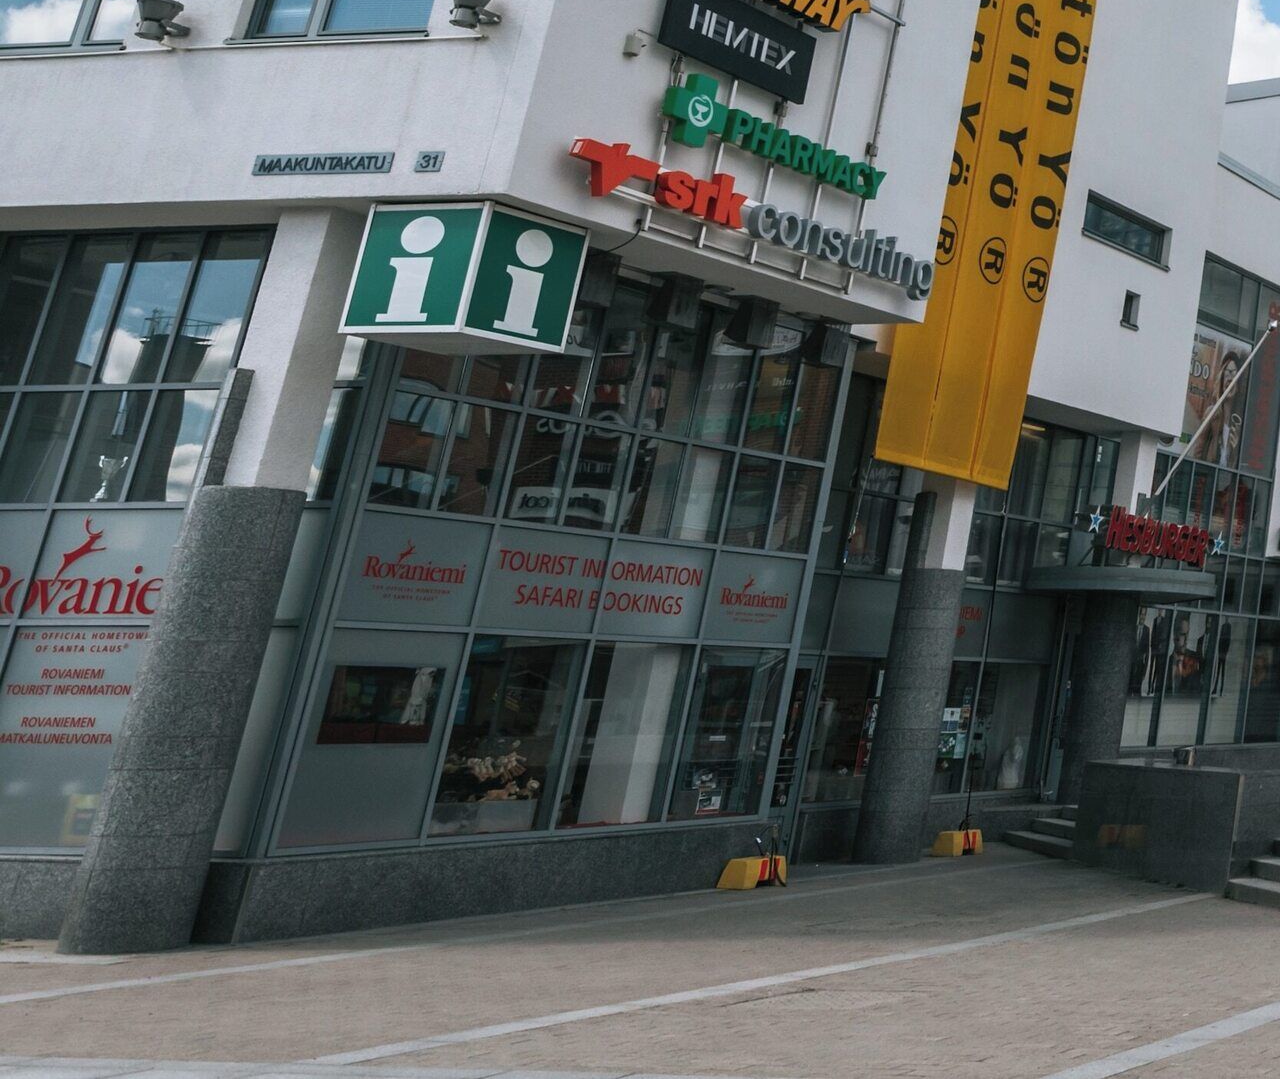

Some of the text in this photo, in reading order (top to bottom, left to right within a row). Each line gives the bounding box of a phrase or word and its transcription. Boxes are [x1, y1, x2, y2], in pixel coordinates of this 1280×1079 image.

[688, 3, 798, 76] HEMTEX
[257, 155, 387, 173] MAAKUNTAKATU
[418, 153, 440, 169] 31
[724, 108, 888, 200] PHARMACY
[988, 126, 1028, 210] Yö
[1029, 150, 1072, 231] Yö
[656, 169, 935, 300] srk consulting
[1105, 505, 1209, 568] HESBURGER
[362, 554, 467, 585] Rovaniemi
[500, 550, 704, 588] TOURIST INORMATION
[515, 584, 582, 608] SAFARI
[720, 587, 789, 610] Rovaniemi
[41, 632, 87, 640] OFFICIAL
[35, 645, 48, 653] OF
[52, 645, 86, 653] SANTA
[41, 669, 105, 680] ROVANIEMI
[6, 685, 132, 696] TOURIST INFORMATION
[20, 717, 96, 728] ROVANIEMEN
